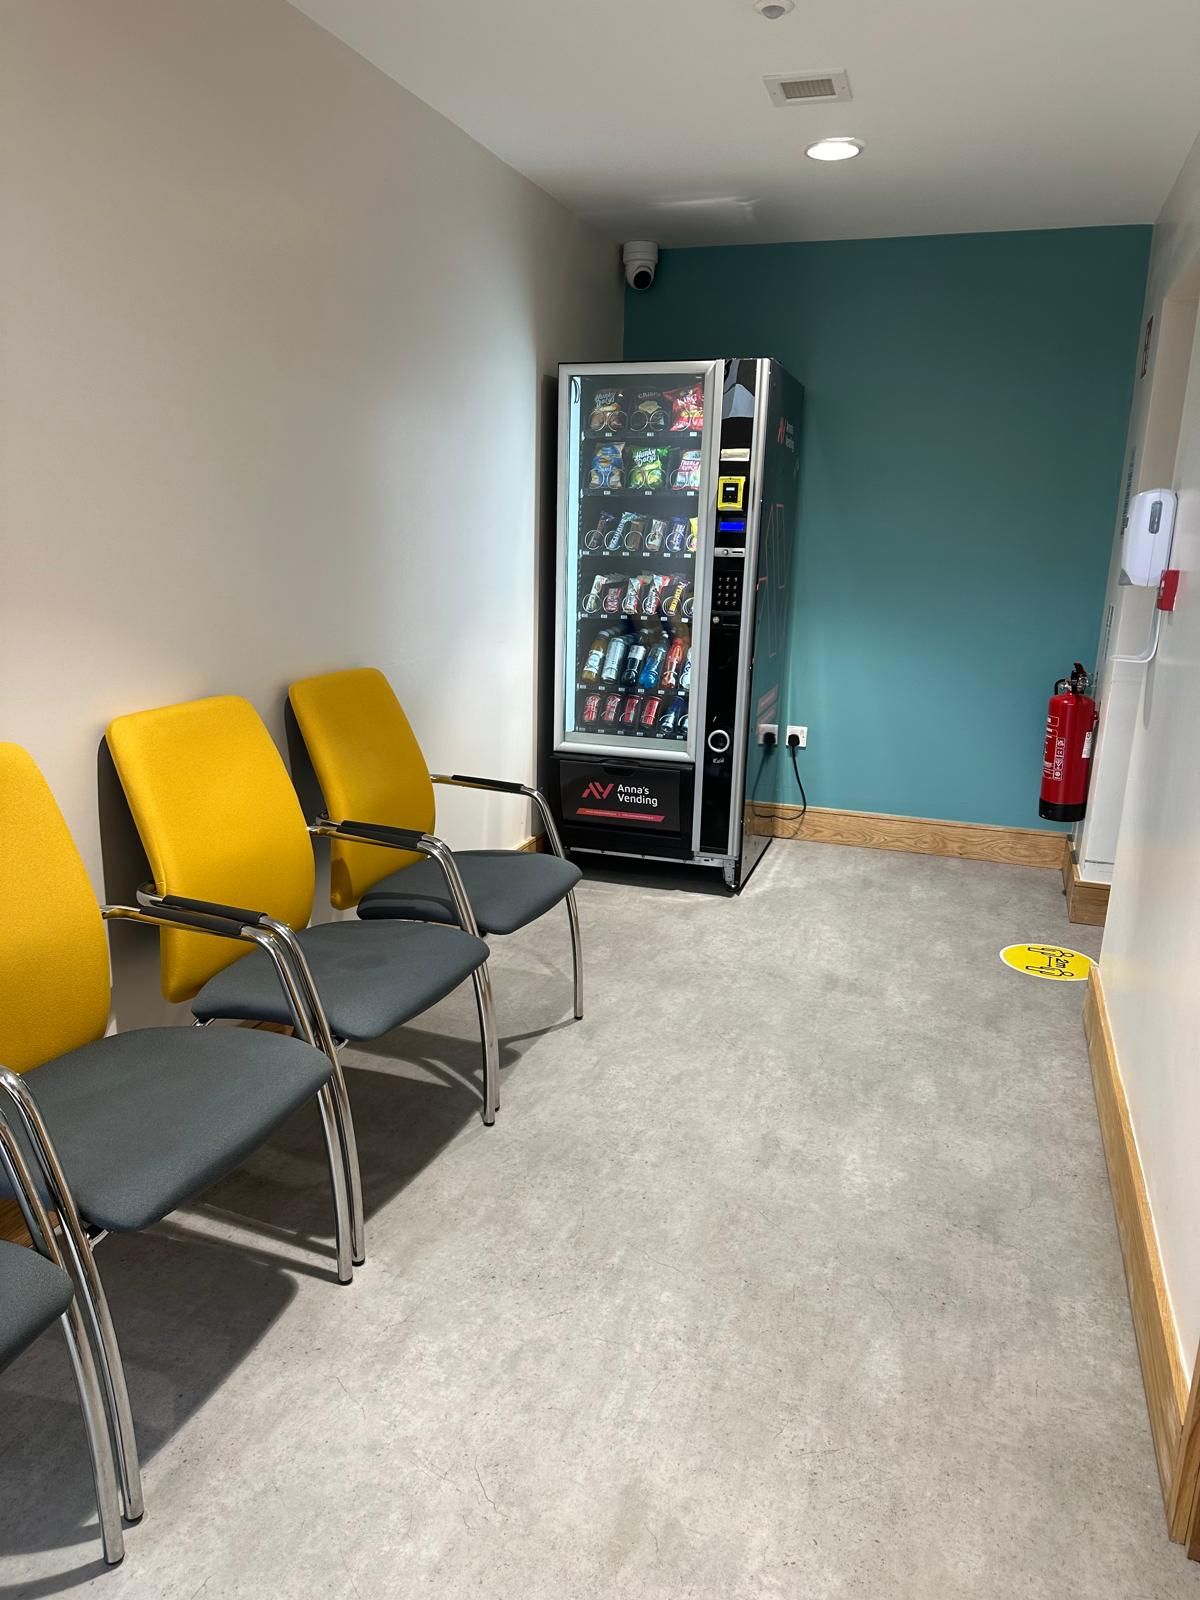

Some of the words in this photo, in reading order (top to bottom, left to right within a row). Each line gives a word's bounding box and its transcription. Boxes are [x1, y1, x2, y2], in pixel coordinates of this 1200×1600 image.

[634, 447, 657, 459] Hunky
[617, 783, 650, 795] Anna's
[617, 793, 658, 808] Vending
